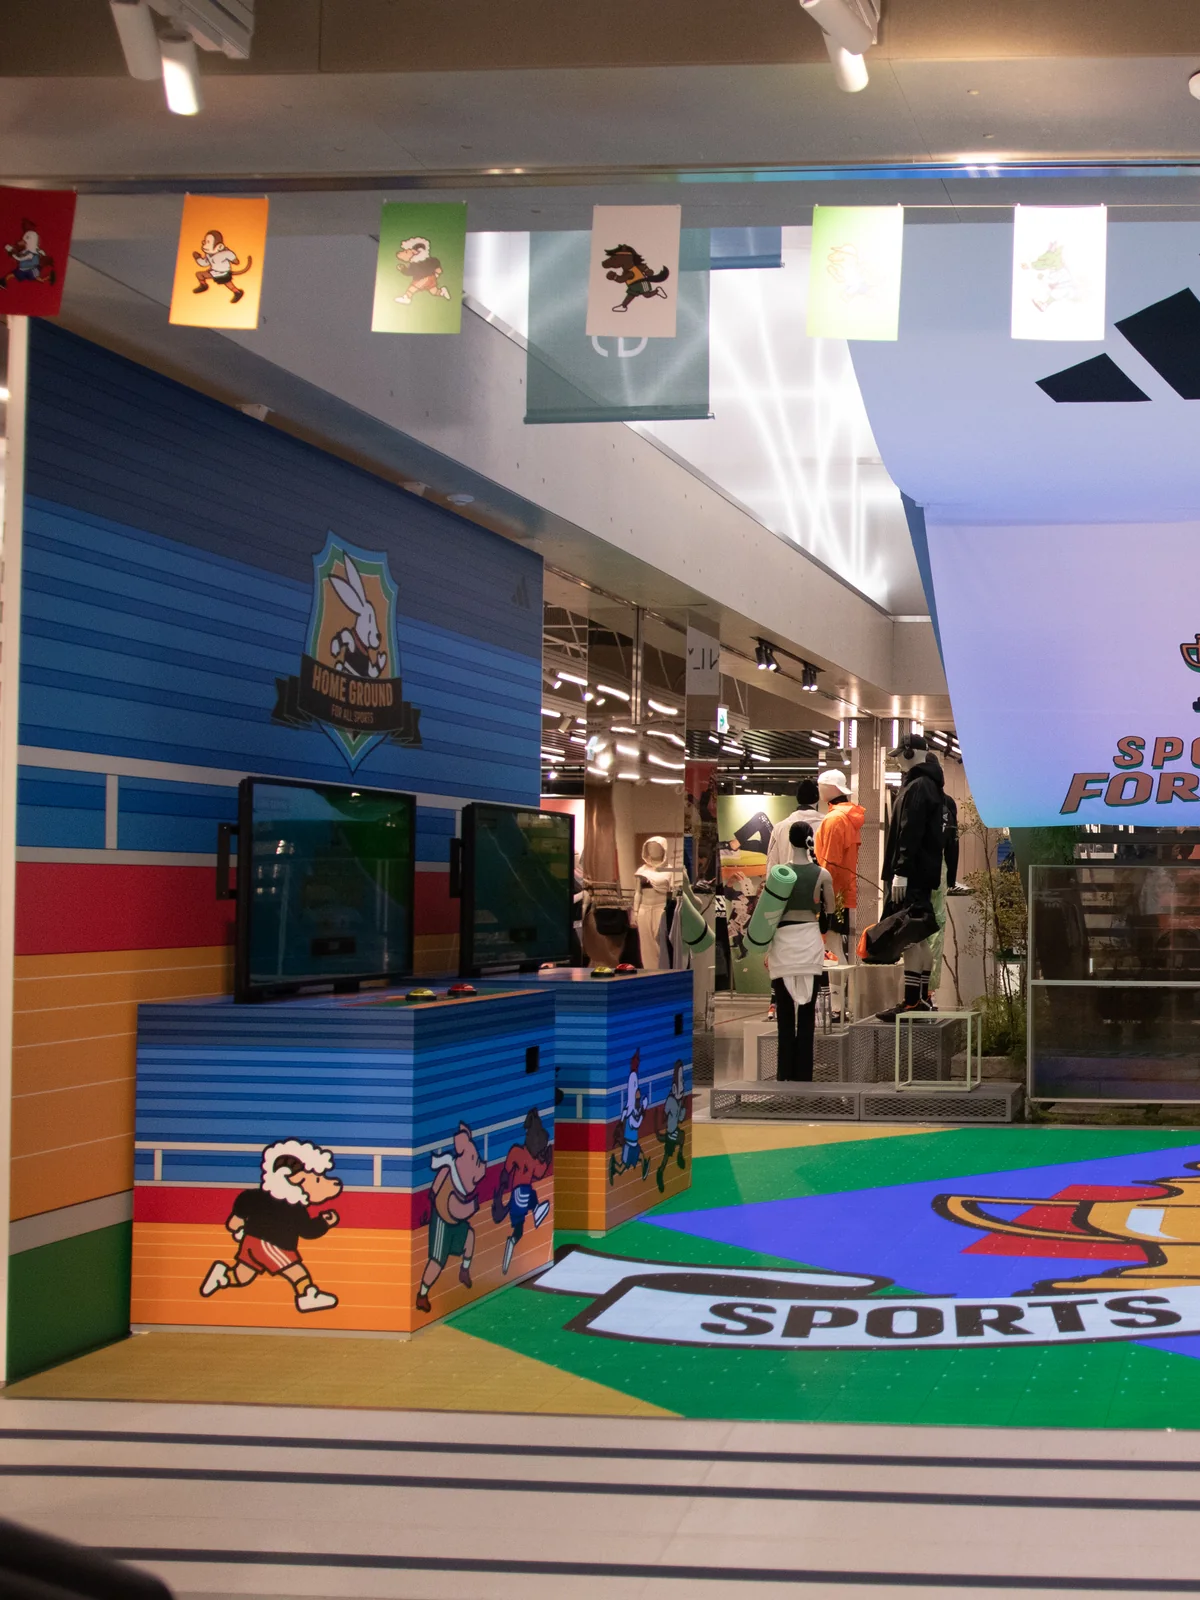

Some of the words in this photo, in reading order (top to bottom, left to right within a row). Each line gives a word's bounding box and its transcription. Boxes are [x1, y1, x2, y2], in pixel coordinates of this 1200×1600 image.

[312, 664, 346, 702] HOME
[349, 680, 393, 707] GROUND
[331, 704, 342, 718] FOR
[343, 708, 353, 722] ALL
[353, 710, 374, 724] SPORTS
[700, 1295, 1183, 1339] SPORTS
